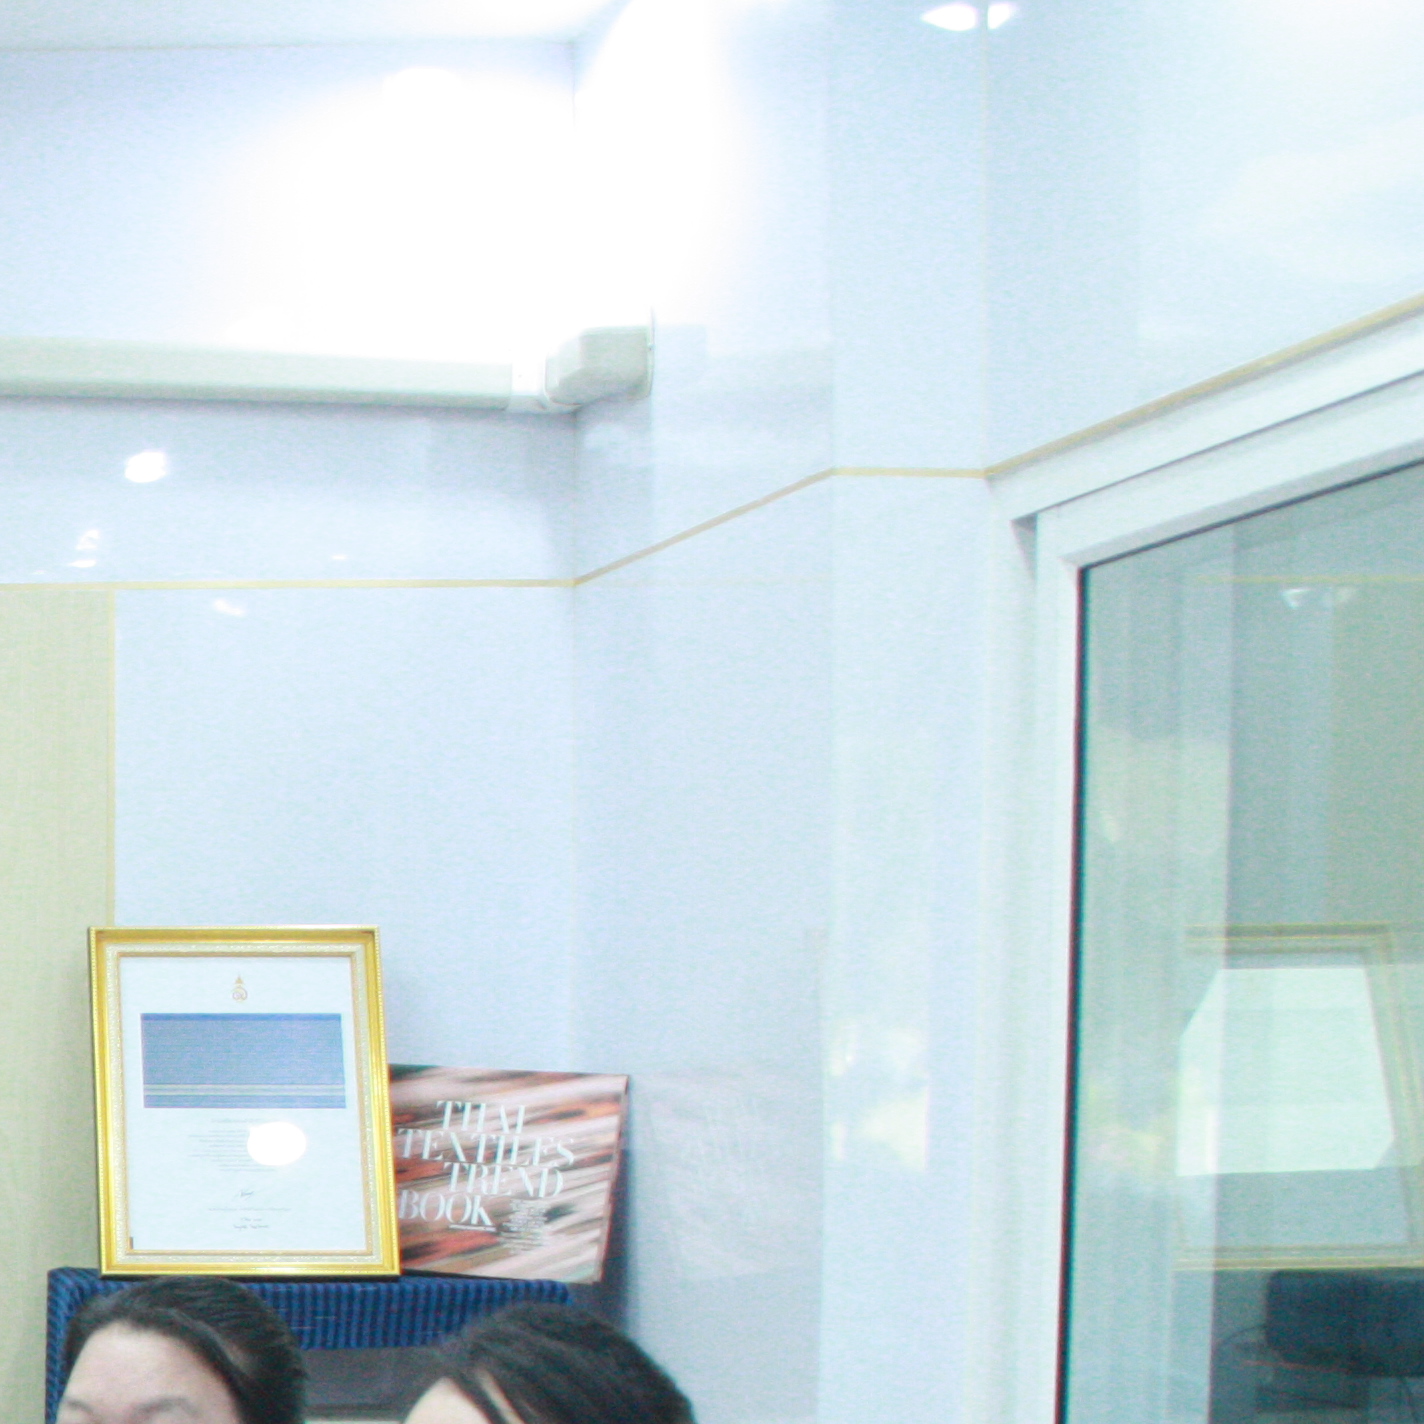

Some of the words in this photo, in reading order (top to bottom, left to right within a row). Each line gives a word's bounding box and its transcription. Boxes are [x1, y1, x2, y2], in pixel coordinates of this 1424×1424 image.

[436, 1100, 526, 1134] THAI
[397, 1128, 575, 1167] TEXTILES
[443, 1161, 565, 1198] TREND
[398, 1189, 494, 1226] BOOK
